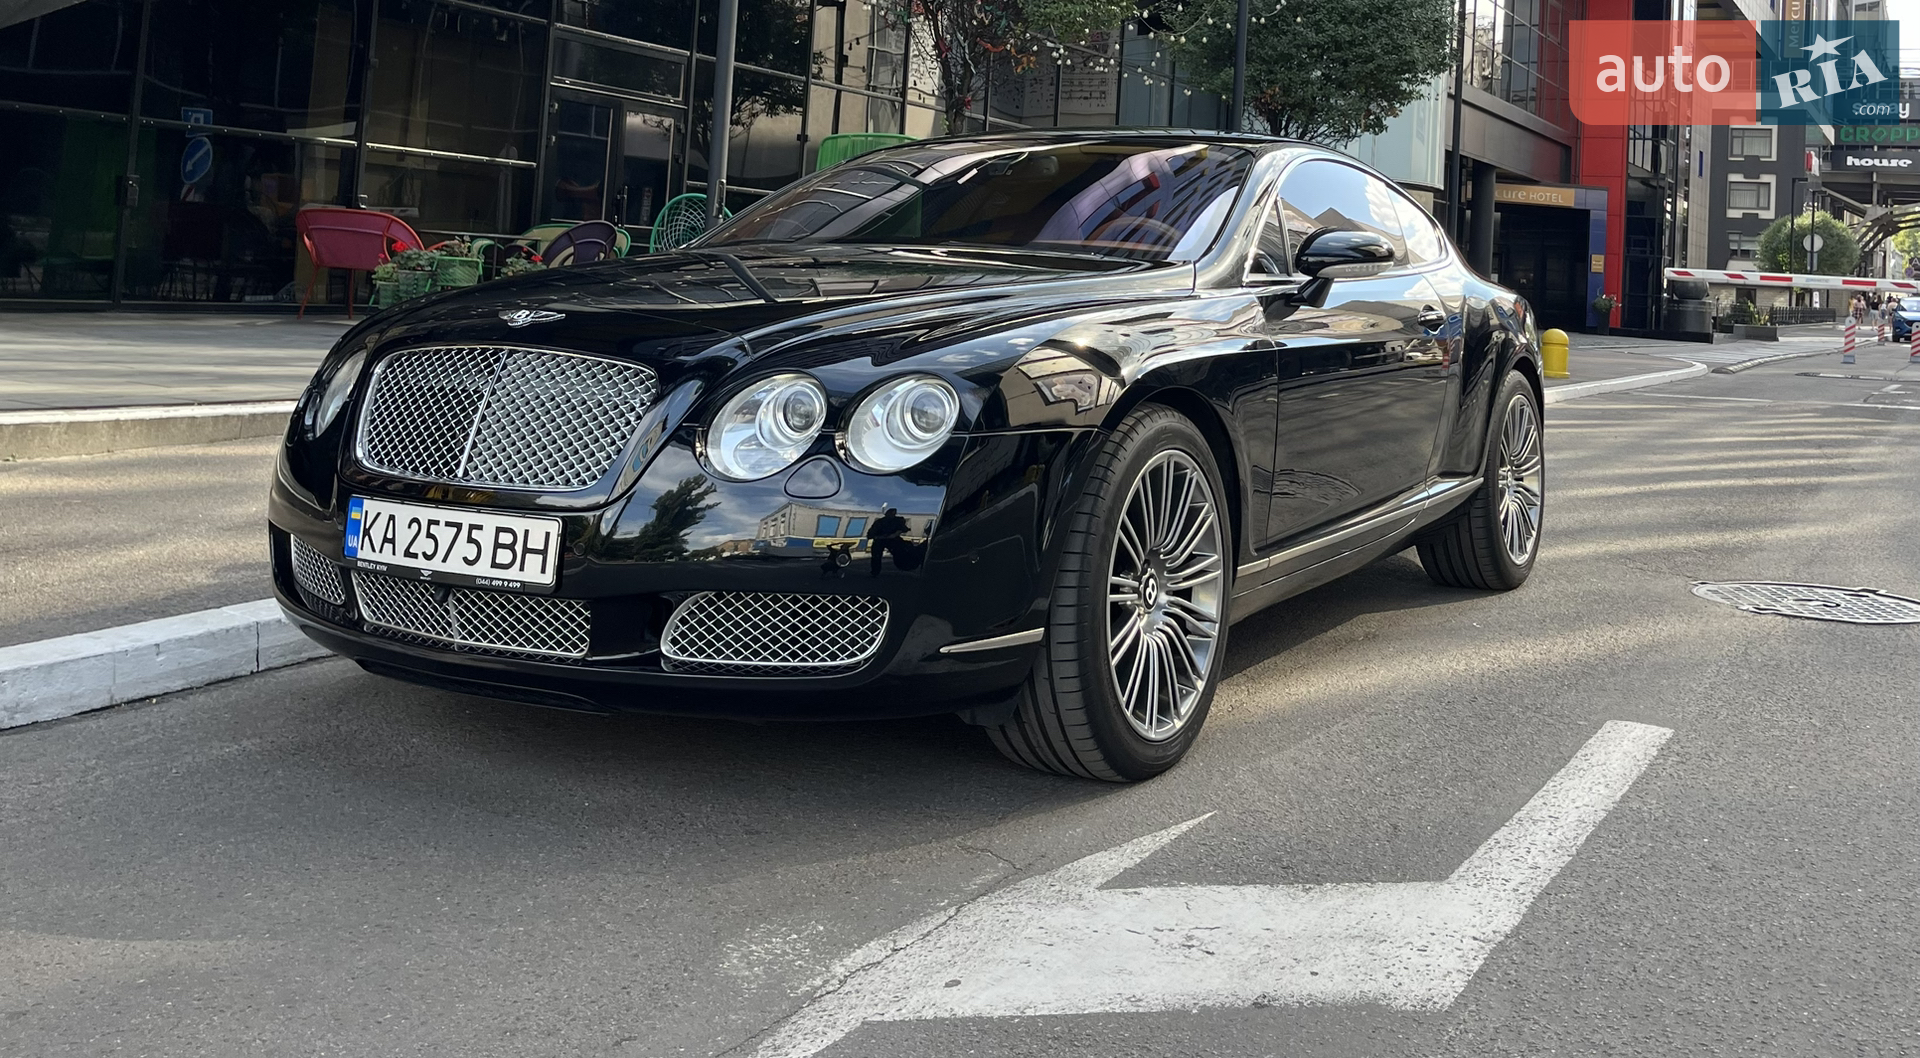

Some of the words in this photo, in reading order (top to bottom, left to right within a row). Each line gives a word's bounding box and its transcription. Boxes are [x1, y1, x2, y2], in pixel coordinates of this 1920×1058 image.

[1840, 126, 1920, 142] CROPP
[1846, 156, 1913, 167] house
[1529, 191, 1564, 203] HOTEL
[348, 534, 358, 548] UA
[360, 510, 397, 556] KA
[403, 517, 484, 566] 2575
[490, 525, 551, 574] BH
